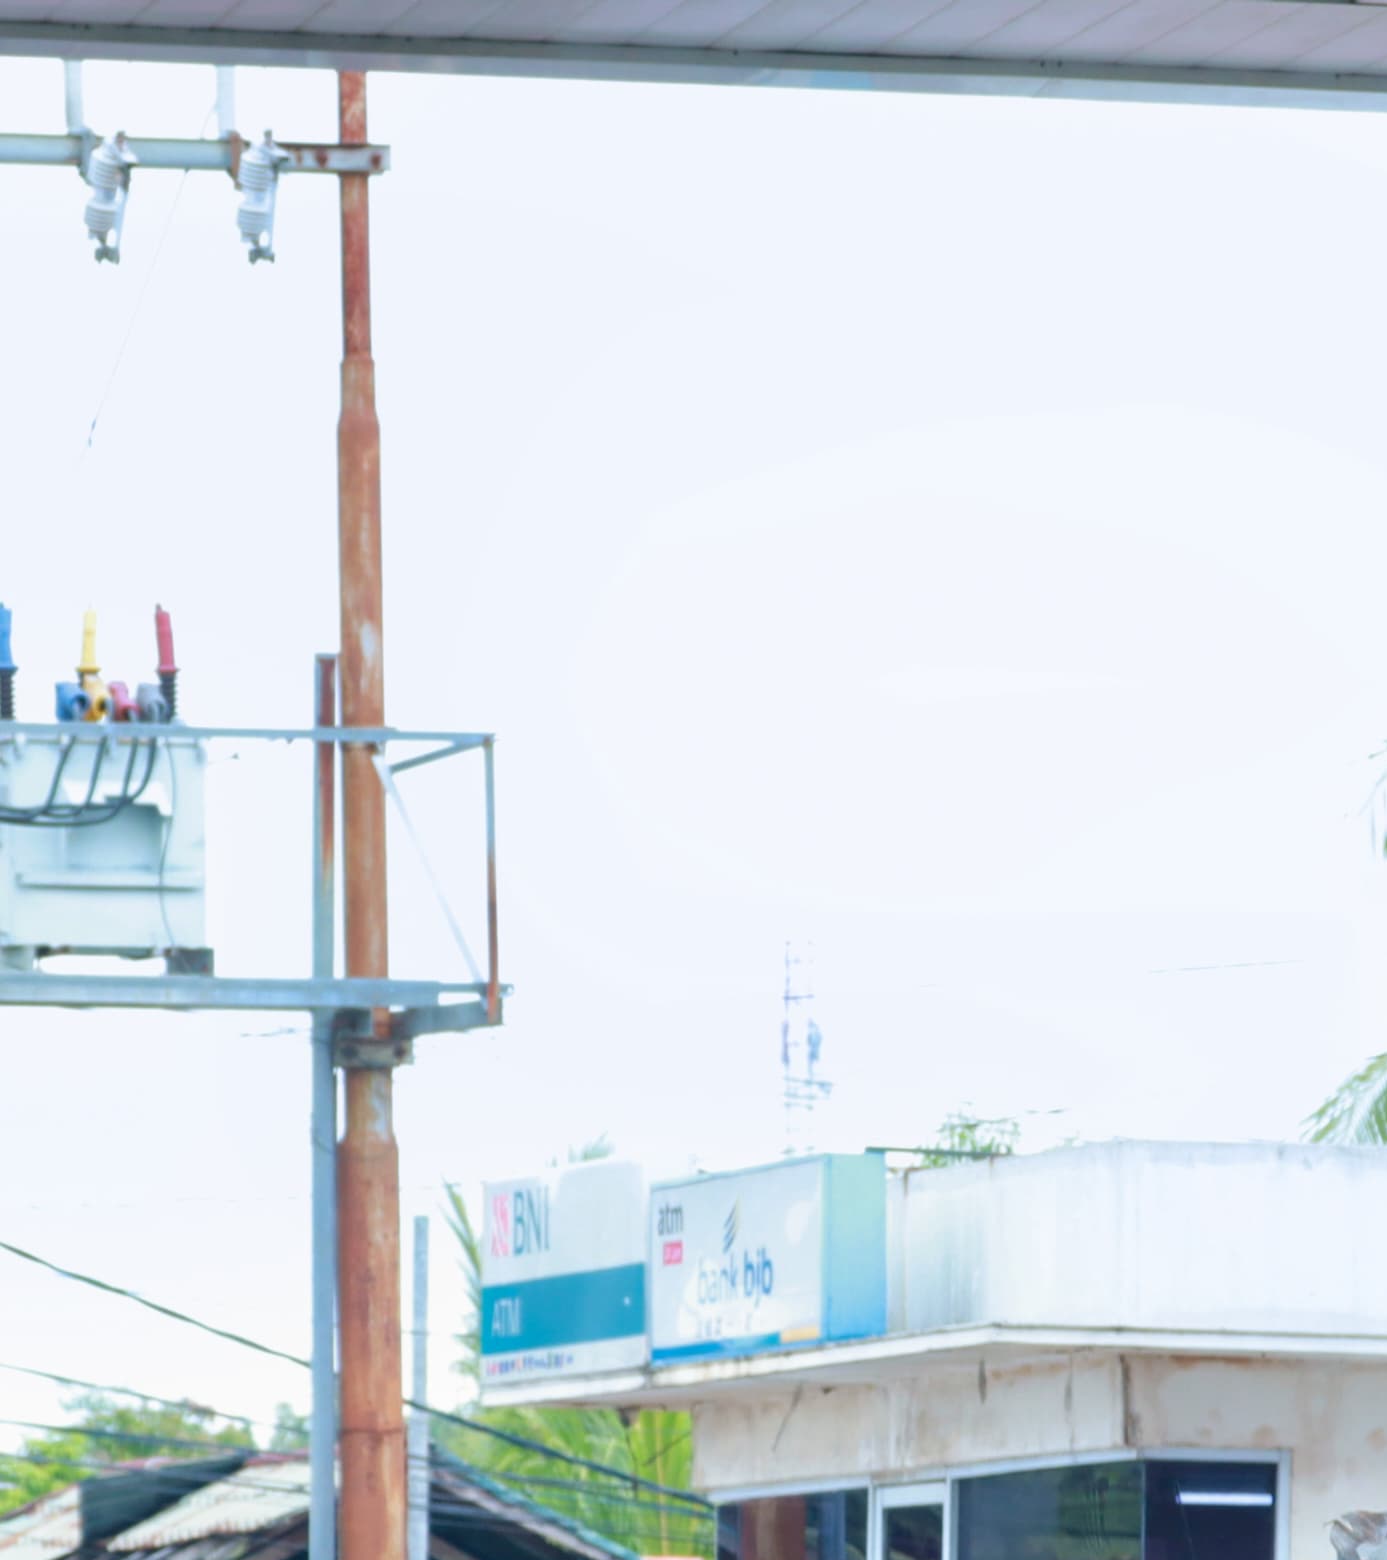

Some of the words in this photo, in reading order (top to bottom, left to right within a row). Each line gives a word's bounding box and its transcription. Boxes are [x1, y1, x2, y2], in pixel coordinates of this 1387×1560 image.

[512, 1185, 551, 1257] BNI
[657, 1204, 684, 1236] atm
[743, 1246, 773, 1309] bjb
[491, 1297, 522, 1338] ATM
